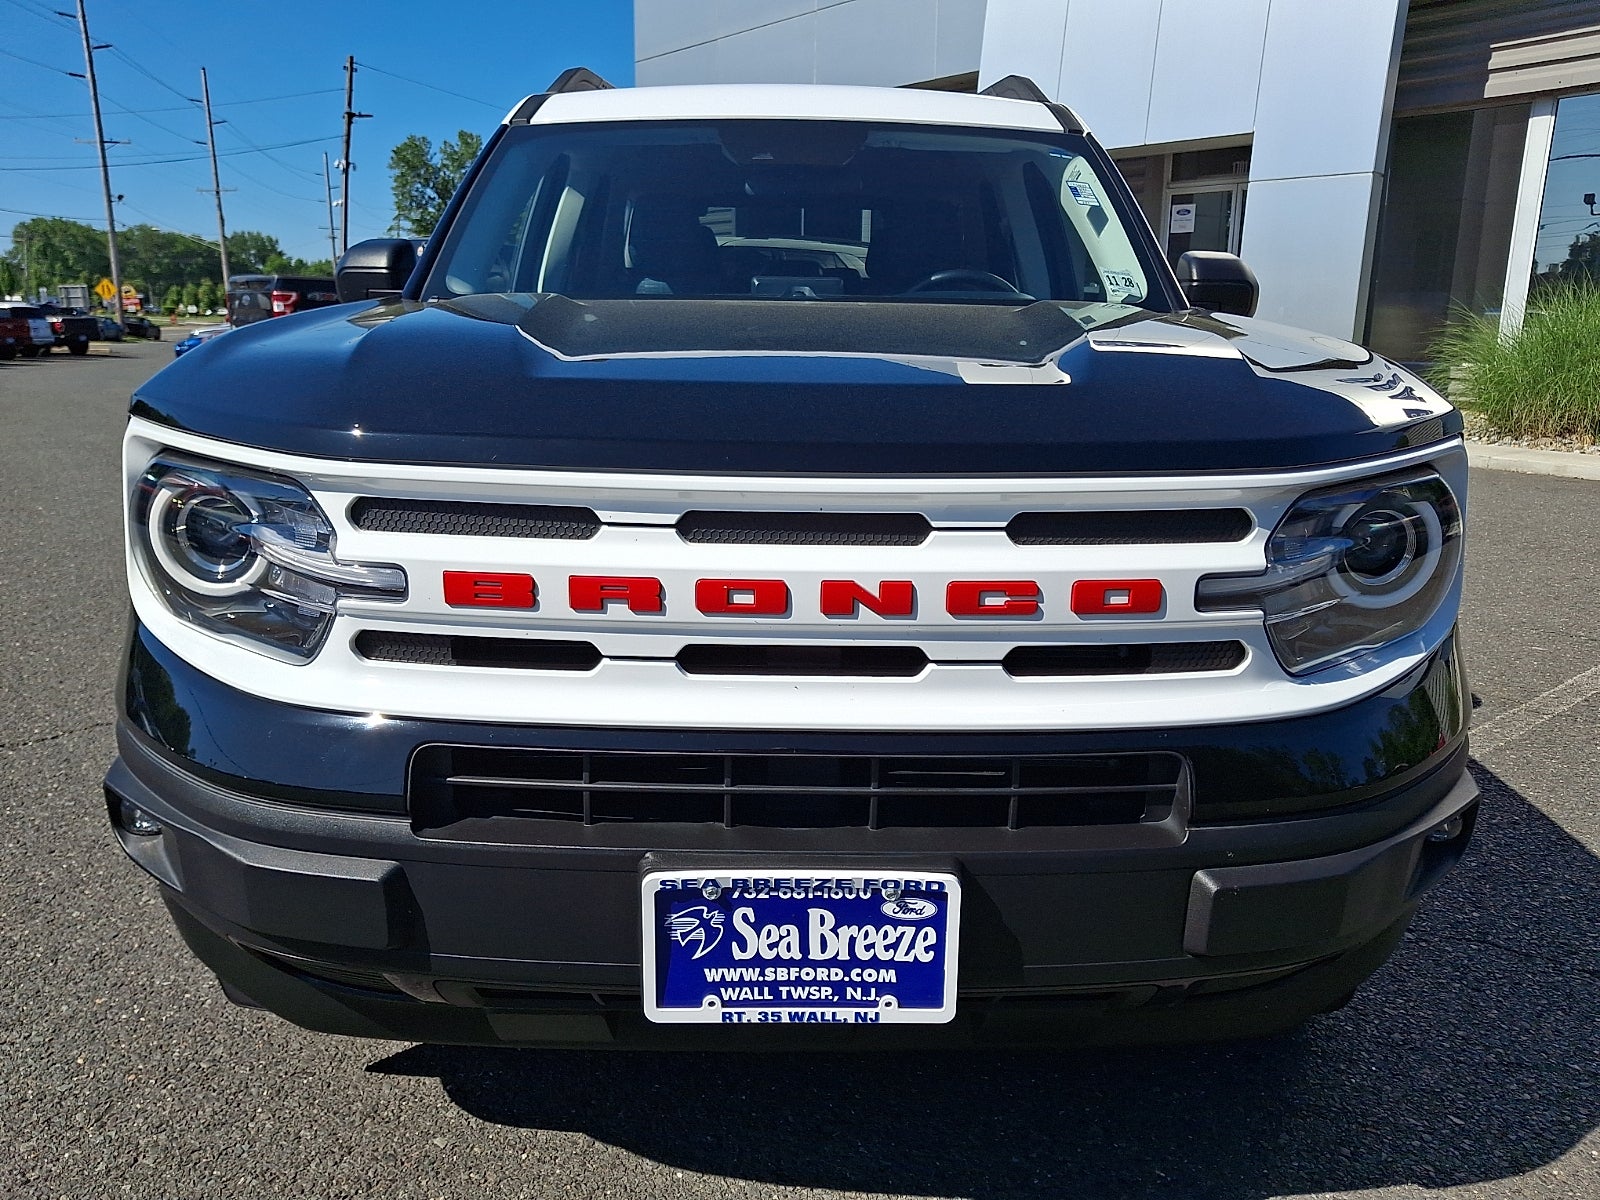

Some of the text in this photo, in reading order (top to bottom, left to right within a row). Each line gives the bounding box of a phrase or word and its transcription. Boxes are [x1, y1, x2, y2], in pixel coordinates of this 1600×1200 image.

[1105, 274, 1135, 288] 11 28
[442, 569, 1163, 616] BRONCO
[659, 878, 947, 892] SEA BREEZE FORD
[892, 900, 926, 916] Ford
[731, 906, 937, 963] Sea Breeze
[703, 966, 897, 983] WWW.SBFORD.COM
[720, 986, 880, 1002] WALL TWSP., N.J.
[721, 1011, 881, 1023] RT. 35 WALL, NJ
